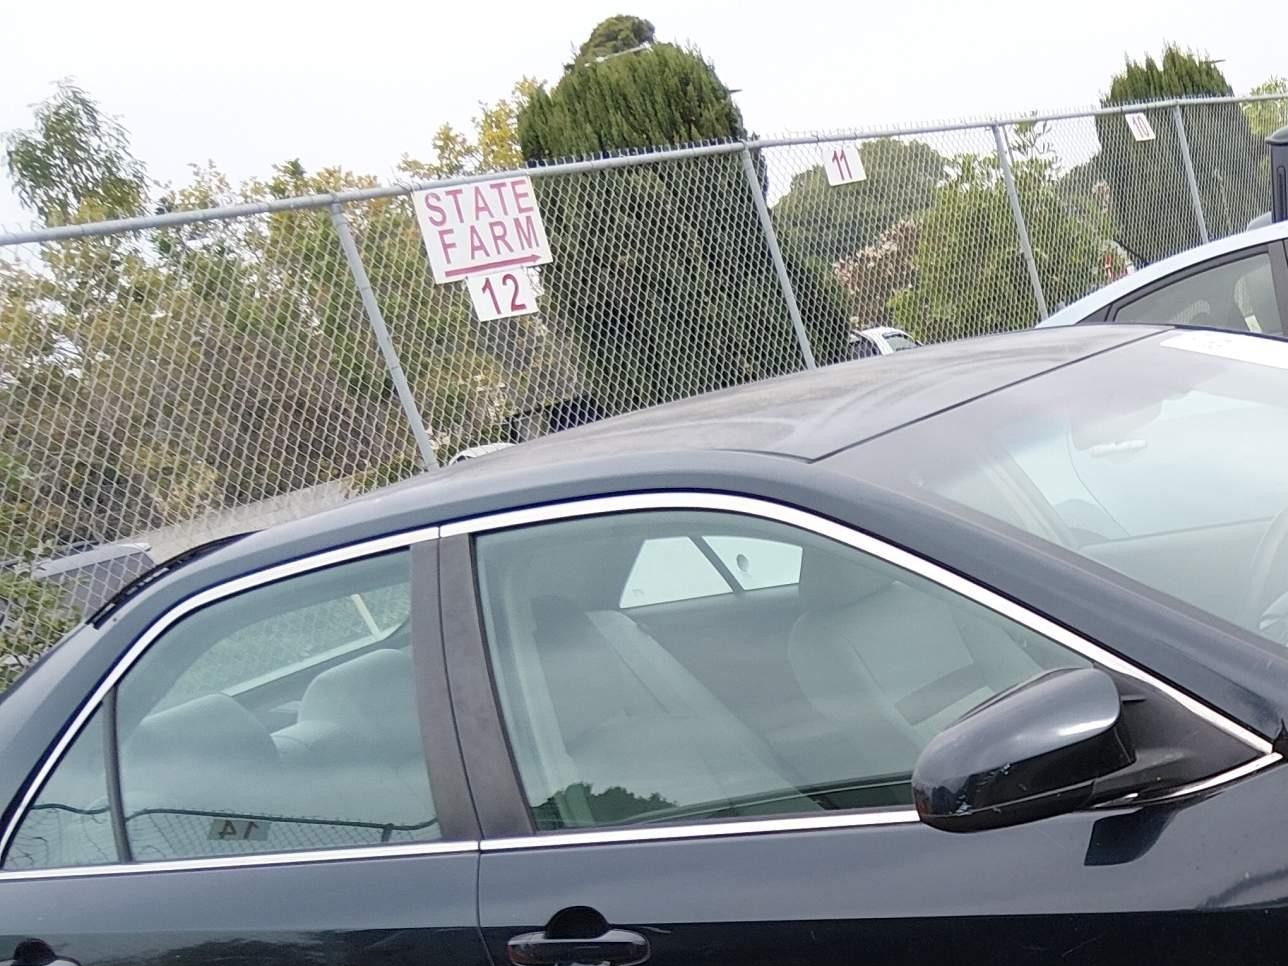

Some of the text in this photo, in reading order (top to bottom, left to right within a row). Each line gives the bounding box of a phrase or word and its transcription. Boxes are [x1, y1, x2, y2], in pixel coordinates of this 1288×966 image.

[832, 149, 853, 180] 11
[424, 179, 534, 227] STATE
[438, 215, 540, 265] FARM
[481, 273, 527, 315] 12
